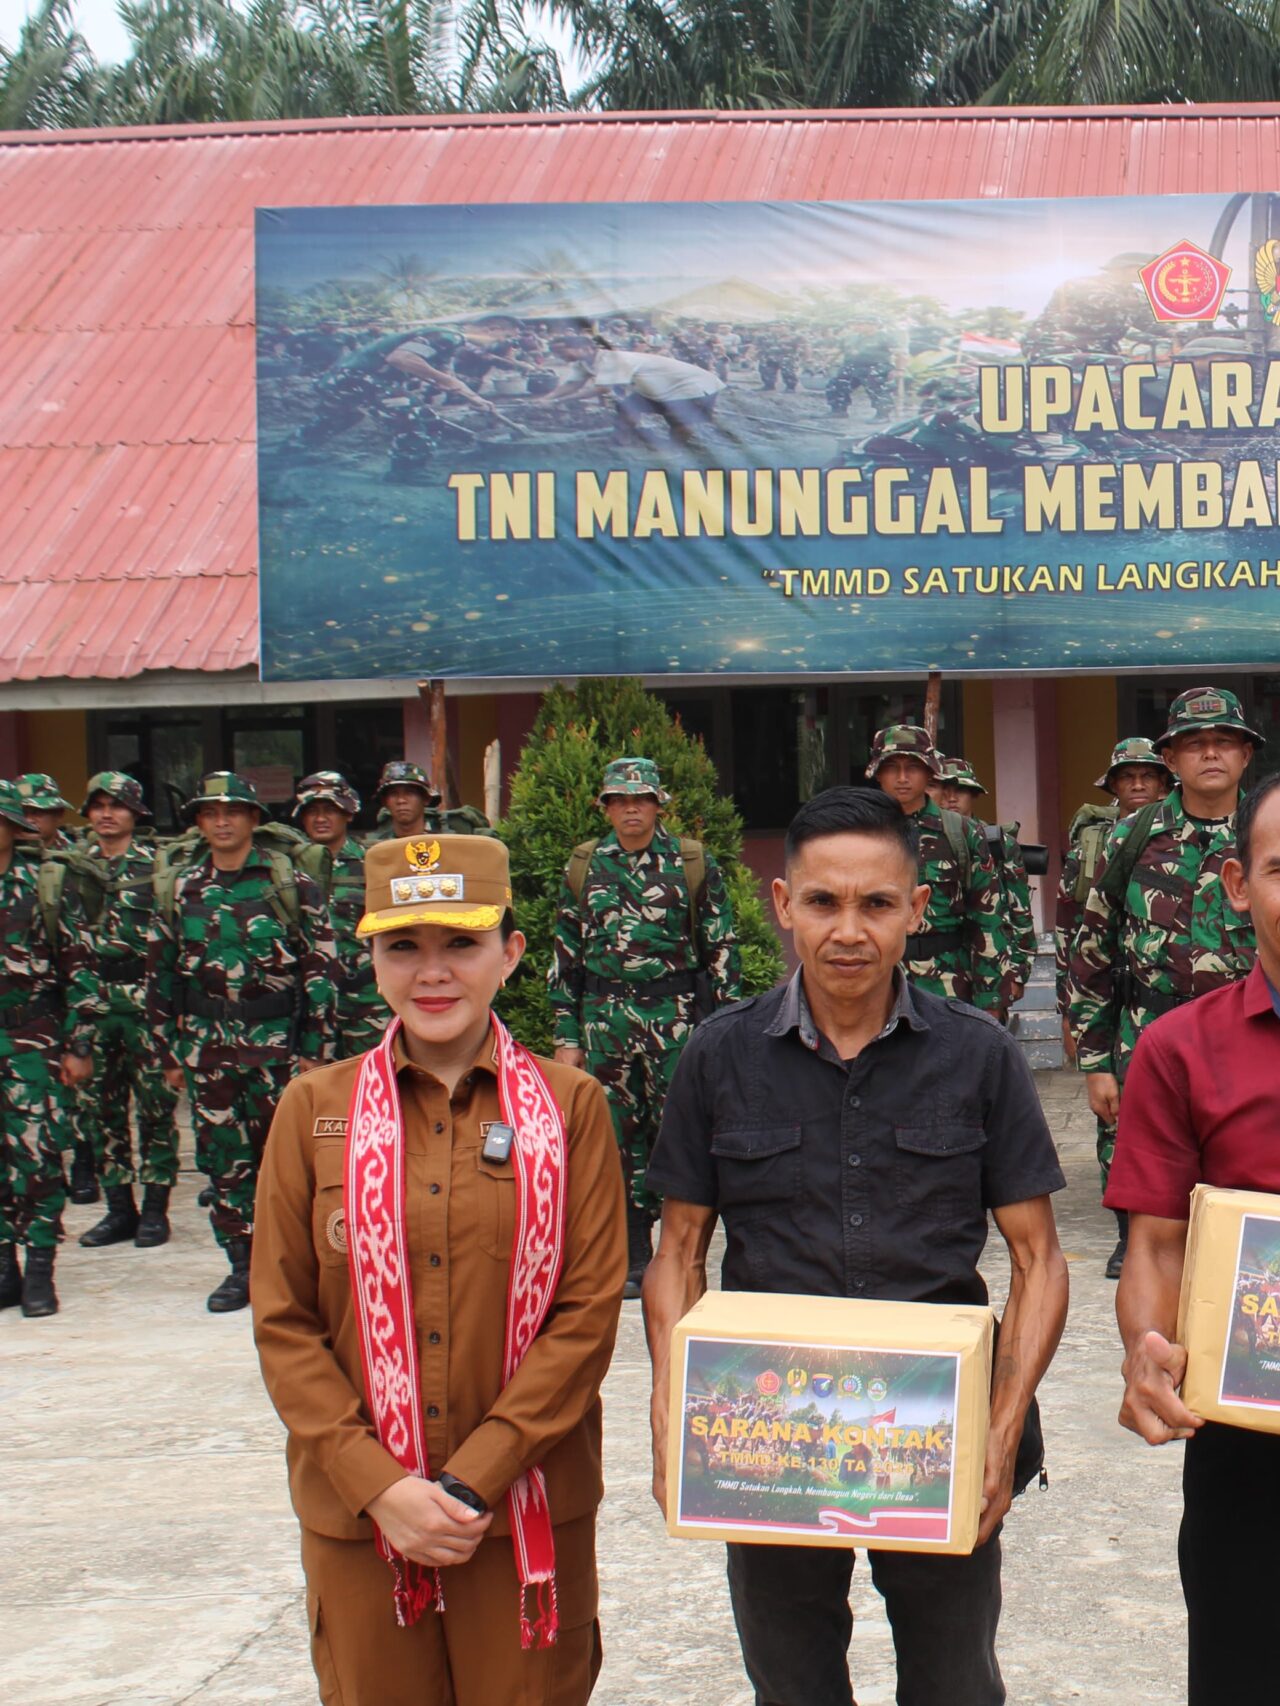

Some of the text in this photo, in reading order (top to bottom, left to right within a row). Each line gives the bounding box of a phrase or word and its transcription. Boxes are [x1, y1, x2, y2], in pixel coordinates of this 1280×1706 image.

[448, 470, 557, 541] TNI
[576, 465, 1003, 539] MANUNGGAL
[762, 568, 891, 597] "TMMD
[904, 562, 1085, 595] SATUKAN
[323, 1120, 348, 1132] KA
[690, 1415, 946, 1450] SARANA KONTAK
[720, 1451, 771, 1467] TMMD
[845, 1459, 867, 1473] TA
[739, 1481, 771, 1493] Satukan
[771, 1484, 803, 1496] Langkah,
[805, 1486, 850, 1498] Membangun
[851, 1489, 877, 1500] Negeri
[878, 1490, 894, 1500] dari
